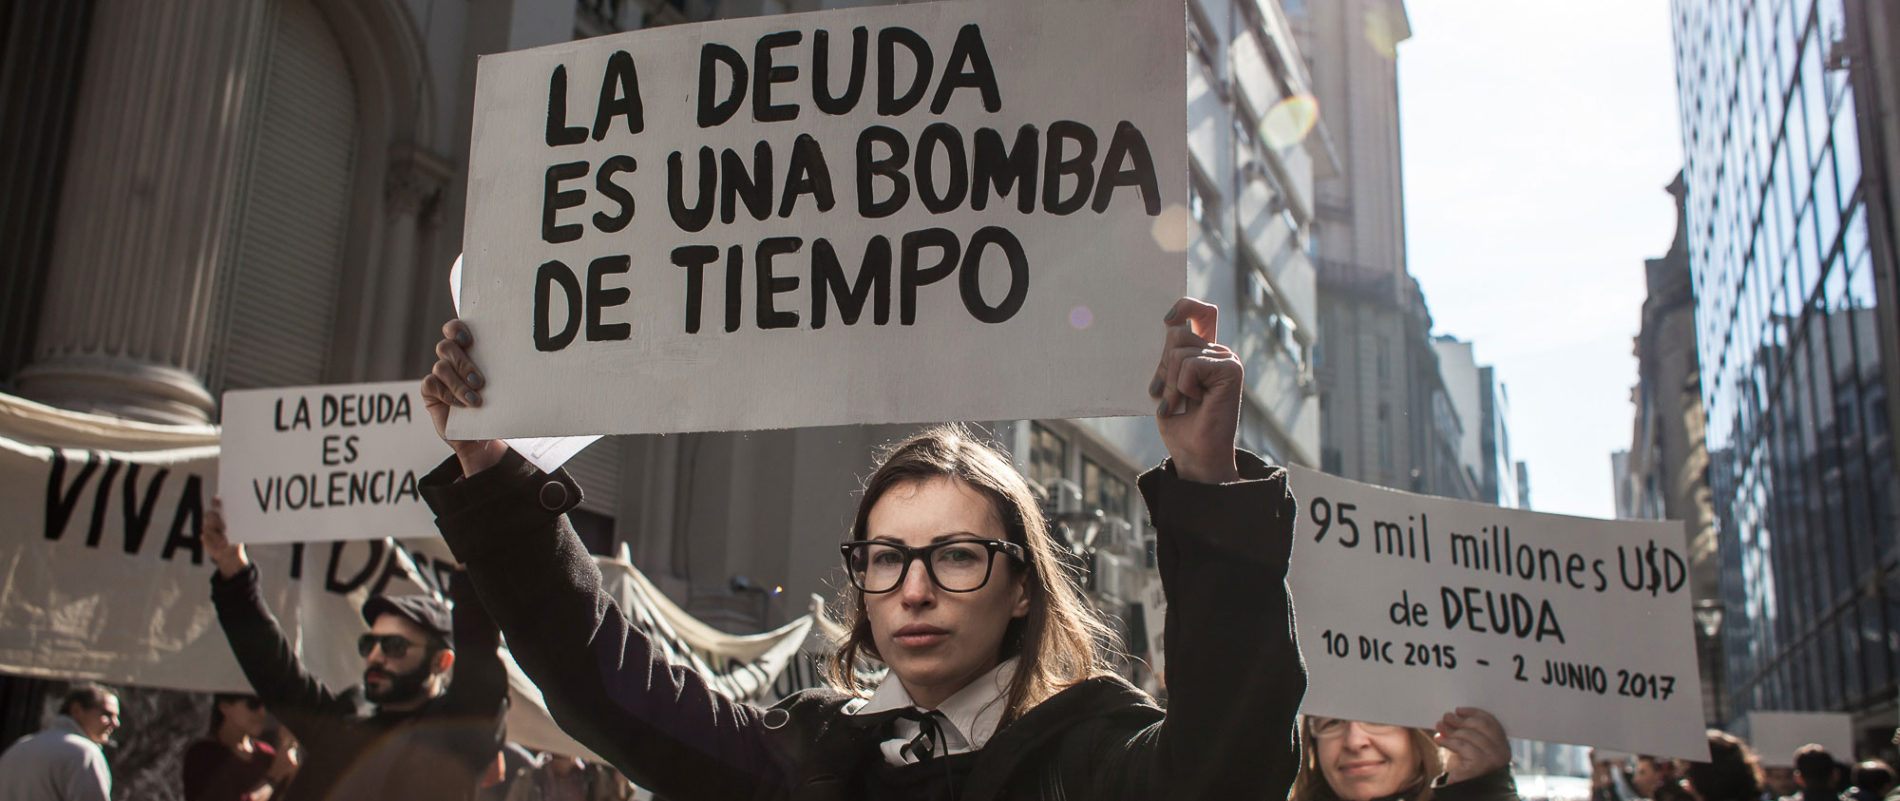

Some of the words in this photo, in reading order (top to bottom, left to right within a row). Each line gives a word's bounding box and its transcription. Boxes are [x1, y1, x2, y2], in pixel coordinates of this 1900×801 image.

[546, 50, 644, 147] LA
[697, 24, 1001, 129] DEUDA
[541, 155, 638, 244] ES
[667, 133, 836, 233] UNA
[856, 120, 1161, 218] BOMBA
[533, 255, 632, 352] DE
[670, 226, 1030, 334] TIEMPO
[274, 396, 311, 432] LA
[321, 393, 412, 428] DEUDA
[322, 435, 359, 466] ES
[253, 469, 421, 514] VIOLENCIA
[1309, 497, 1360, 549] 95
[1374, 513, 1431, 563] mil
[1450, 526, 1608, 594] millones
[1617, 540, 1688, 598] U$D
[1389, 590, 1429, 628] de
[1440, 586, 1566, 645] DEUDA
[1321, 630, 1349, 658] 10
[1358, 635, 1395, 665] DIC
[1404, 643, 1457, 671] 2015
[1512, 654, 1529, 682] 2
[1541, 659, 1608, 697] JUNIO
[1616, 669, 1676, 701] 2017
